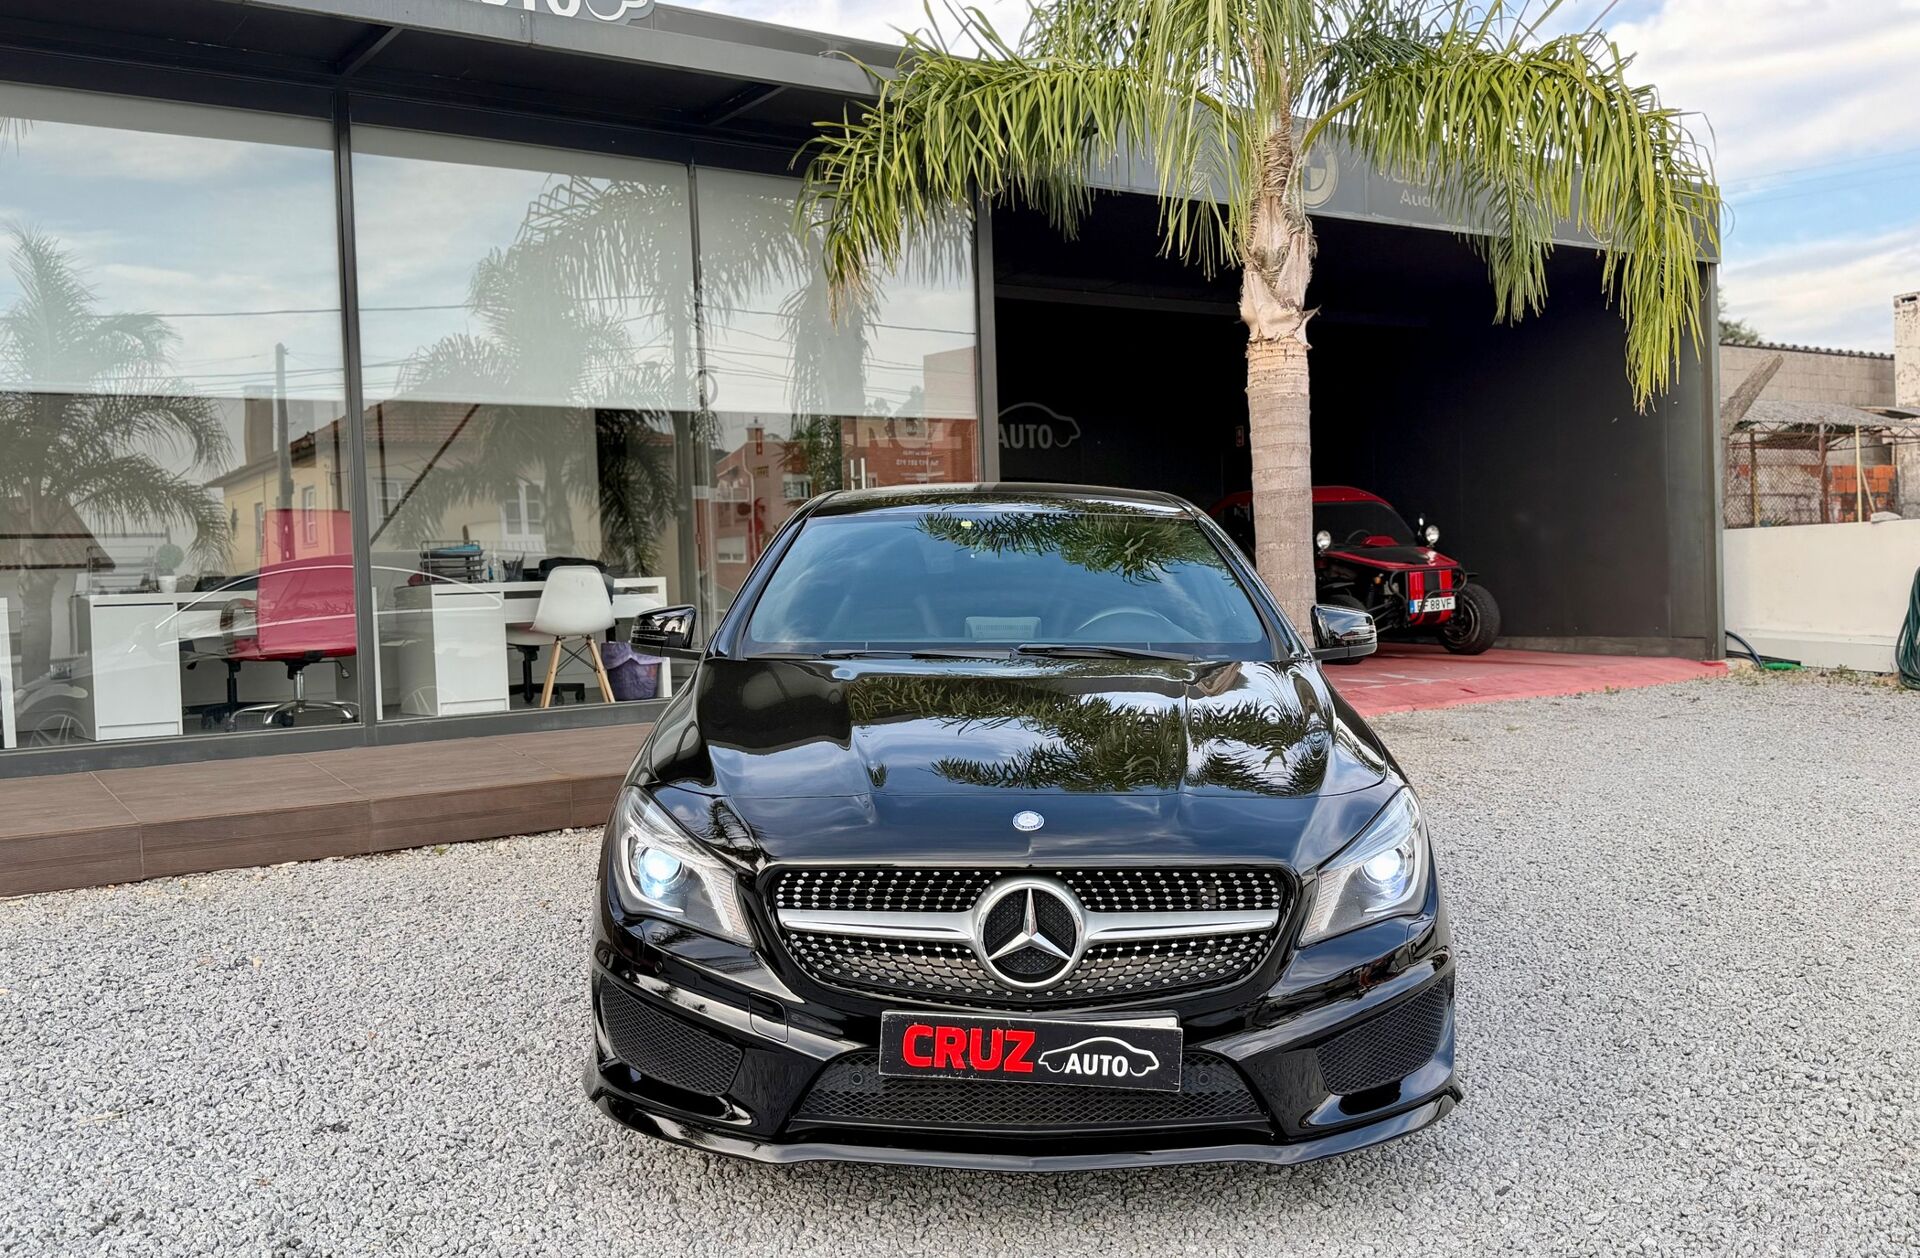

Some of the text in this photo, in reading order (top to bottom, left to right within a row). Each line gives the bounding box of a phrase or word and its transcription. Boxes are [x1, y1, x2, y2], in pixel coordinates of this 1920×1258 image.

[998, 423, 1053, 449] AUTO
[1430, 599, 1440, 610] 88
[1441, 598, 1452, 609] VF
[902, 1024, 1129, 1077] CRUZ AUTO
